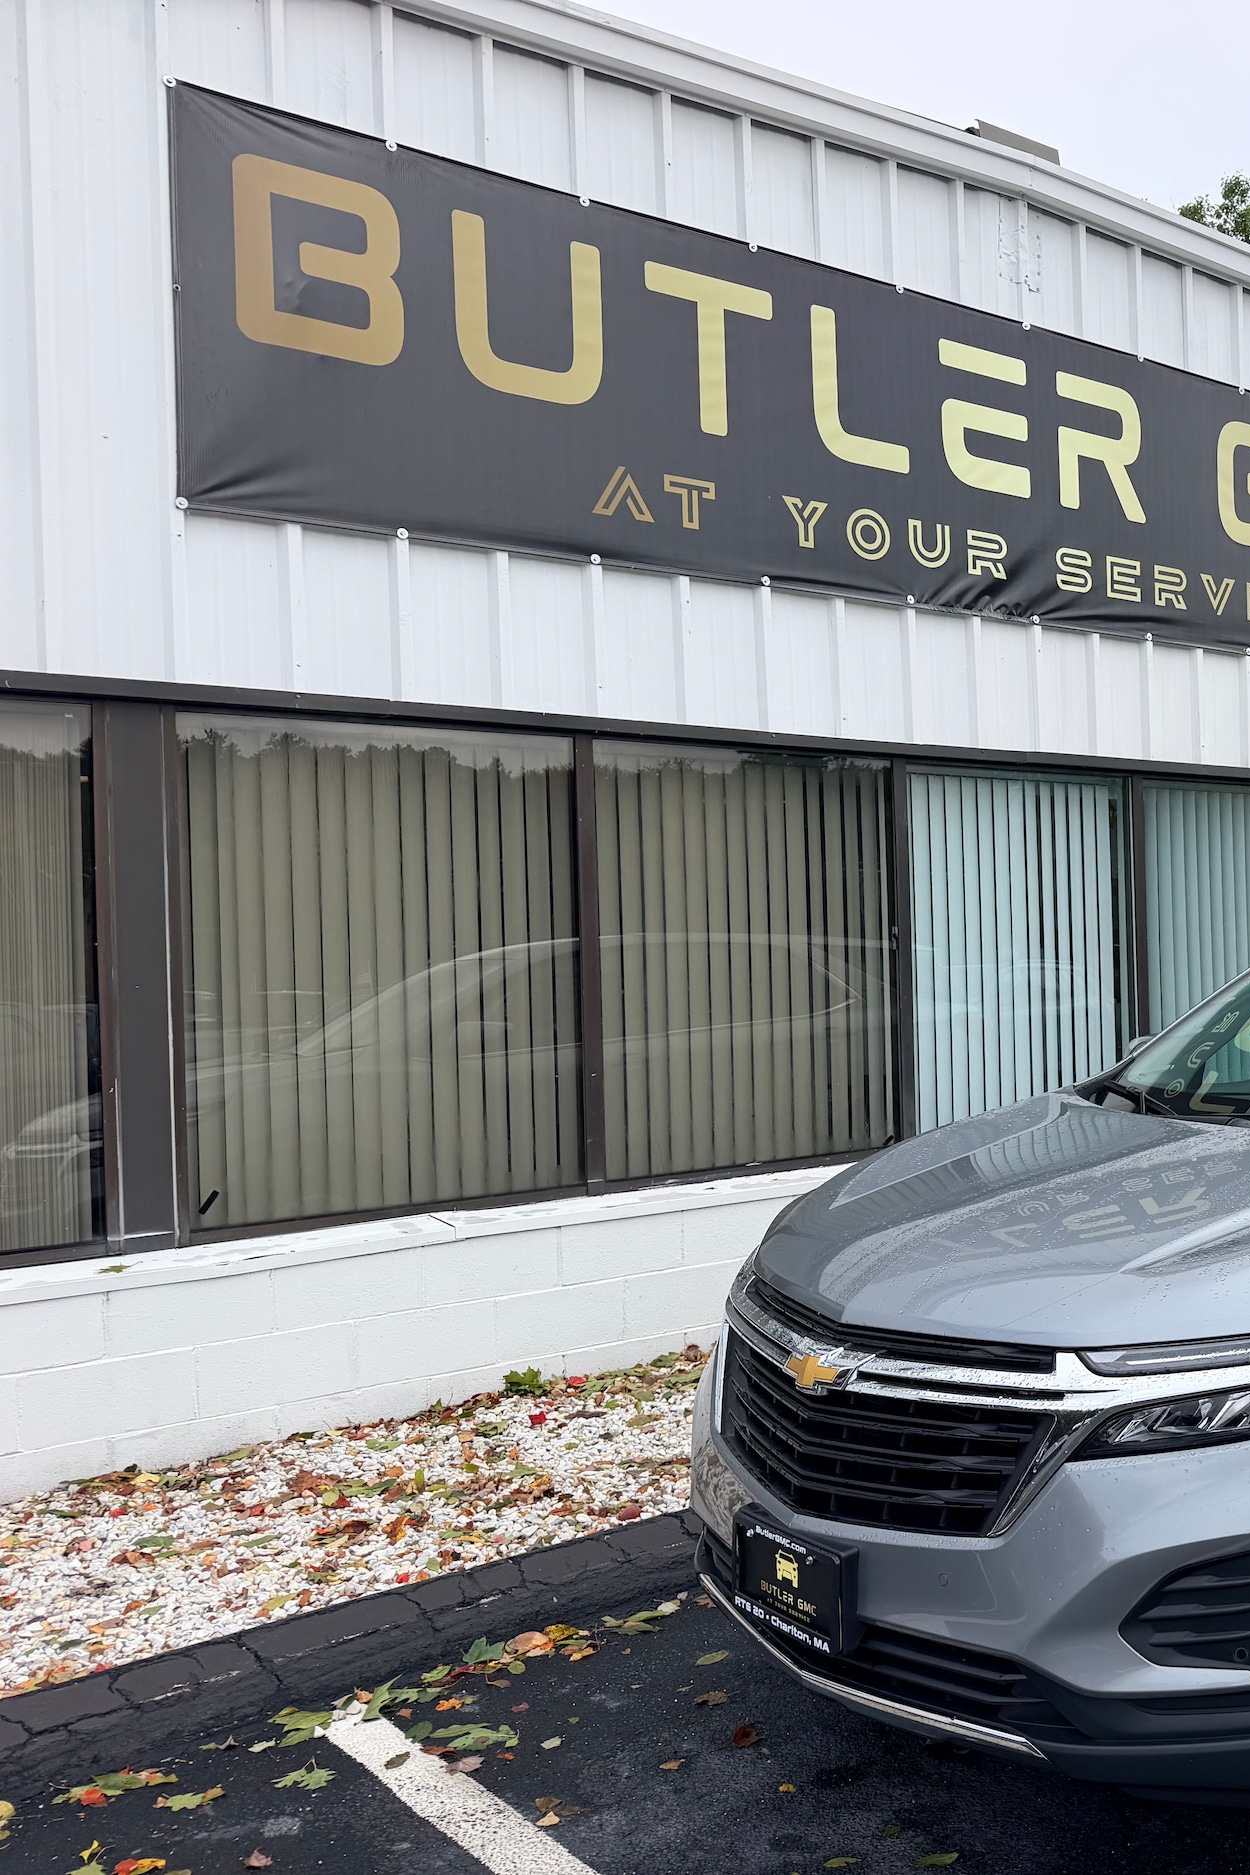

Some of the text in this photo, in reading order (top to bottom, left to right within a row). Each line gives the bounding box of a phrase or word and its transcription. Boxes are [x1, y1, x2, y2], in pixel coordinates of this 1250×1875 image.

[232, 153, 1147, 525] BUTLER
[592, 466, 716, 529] AT
[782, 495, 1008, 580] YOUR
[755, 1525, 806, 1554] ButlerGMC.com
[734, 1595, 831, 1654] RTE 20 Charlton, MA
[760, 1580, 817, 1617] BUTLER GMC
